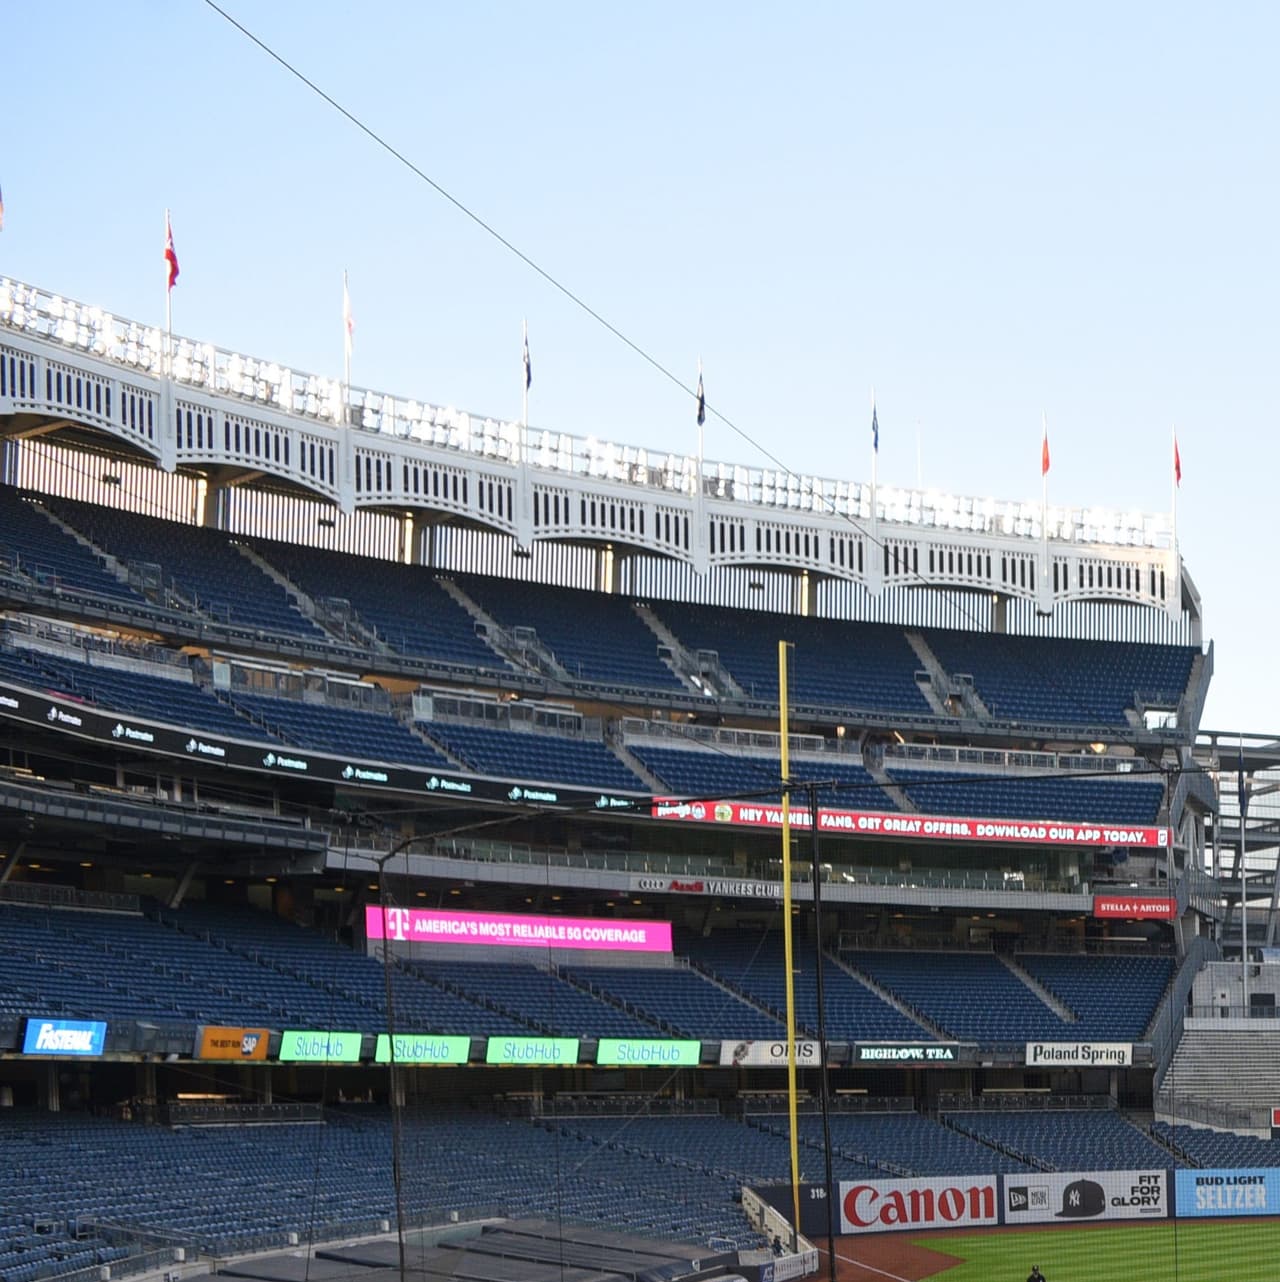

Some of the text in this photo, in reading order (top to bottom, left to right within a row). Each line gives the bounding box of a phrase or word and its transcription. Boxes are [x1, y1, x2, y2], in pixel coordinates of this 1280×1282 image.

[739, 809, 1146, 843] HEY FANS, GET GREAT OFFERS. DOWNLOAD OUR APP TODAY.
[668, 880, 780, 897] Audi YANKEES CLUB
[1101, 903, 1170, 912] STELLA ARTOIS
[414, 918, 646, 943] AMERICA'S MOST RELIABLE 5G COVERAGE
[241, 1035, 258, 1052] SAP
[295, 1035, 343, 1057] StubHub
[394, 1039, 450, 1060] StubHub
[503, 1041, 562, 1060] StubHub
[617, 1043, 681, 1061] StubHub
[926, 1049, 954, 1060] TEA
[1033, 1045, 1126, 1065] Poland Spring
[1139, 1175, 1160, 1186] FIT
[1196, 1175, 1265, 1185] BUD LIGHT
[1131, 1185, 1161, 1196] FOR
[1196, 1184, 1266, 1209] SELTZER
[843, 1184, 995, 1228] Canon
[1111, 1195, 1161, 1208] GLORY
